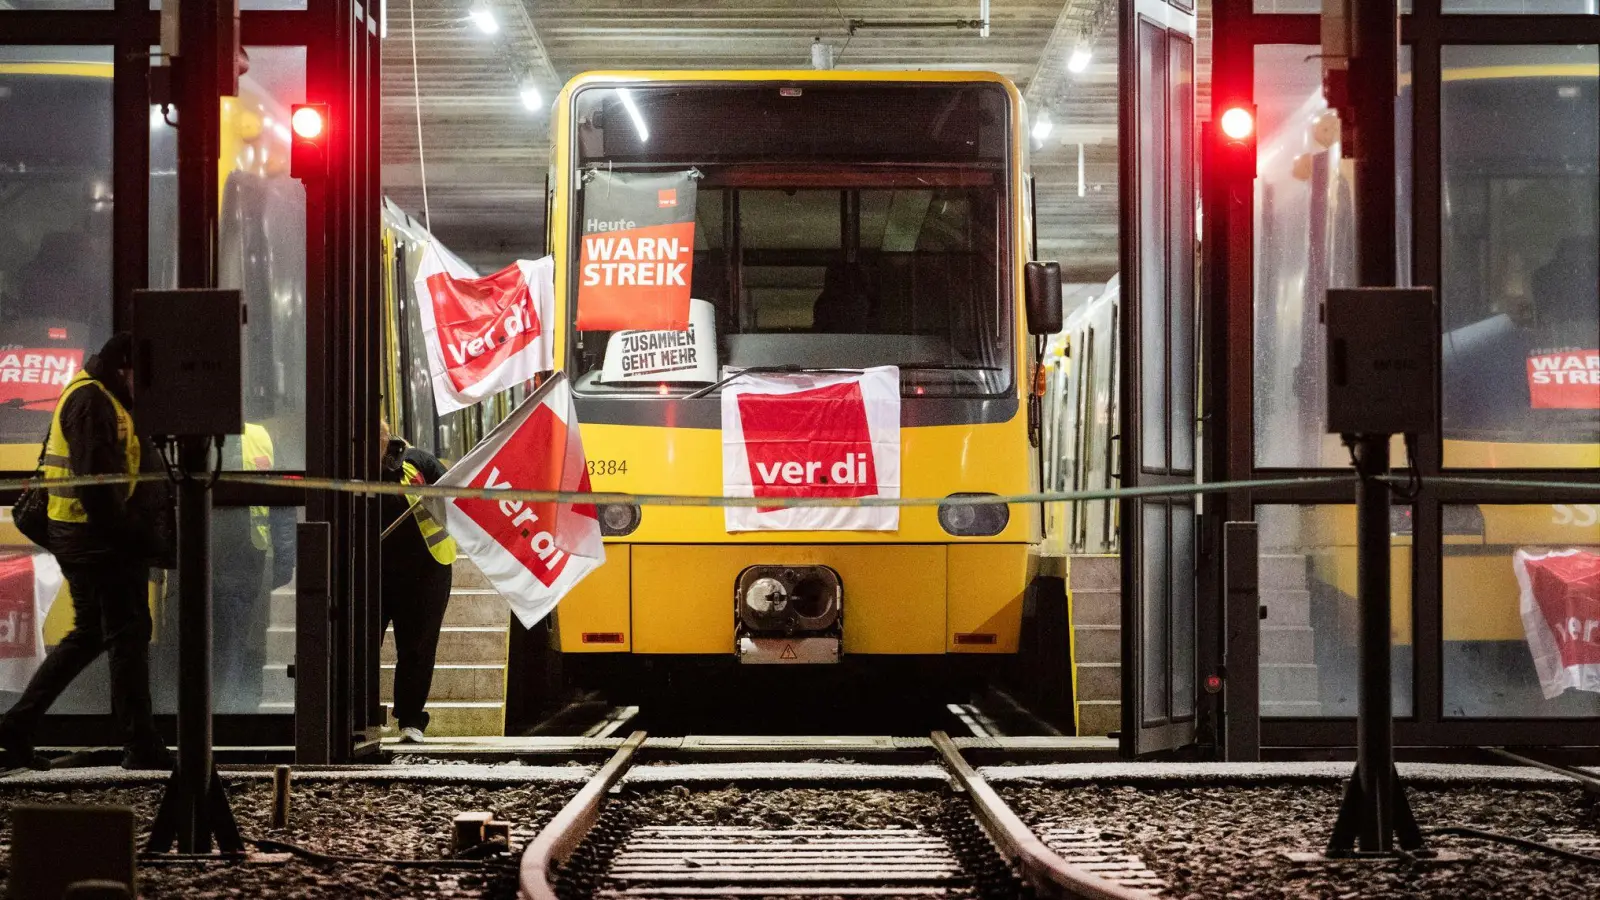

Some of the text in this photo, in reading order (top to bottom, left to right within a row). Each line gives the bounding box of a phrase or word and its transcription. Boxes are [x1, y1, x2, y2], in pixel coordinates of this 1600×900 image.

[586, 219, 636, 232] Heute
[586, 238, 689, 260] WARN-
[583, 262, 687, 286] STREIK
[621, 329, 695, 353] ZUSAMMEN
[622, 348, 697, 371] GEHT MEHR
[587, 459, 628, 476] 3384
[756, 453, 866, 484] ver.di
